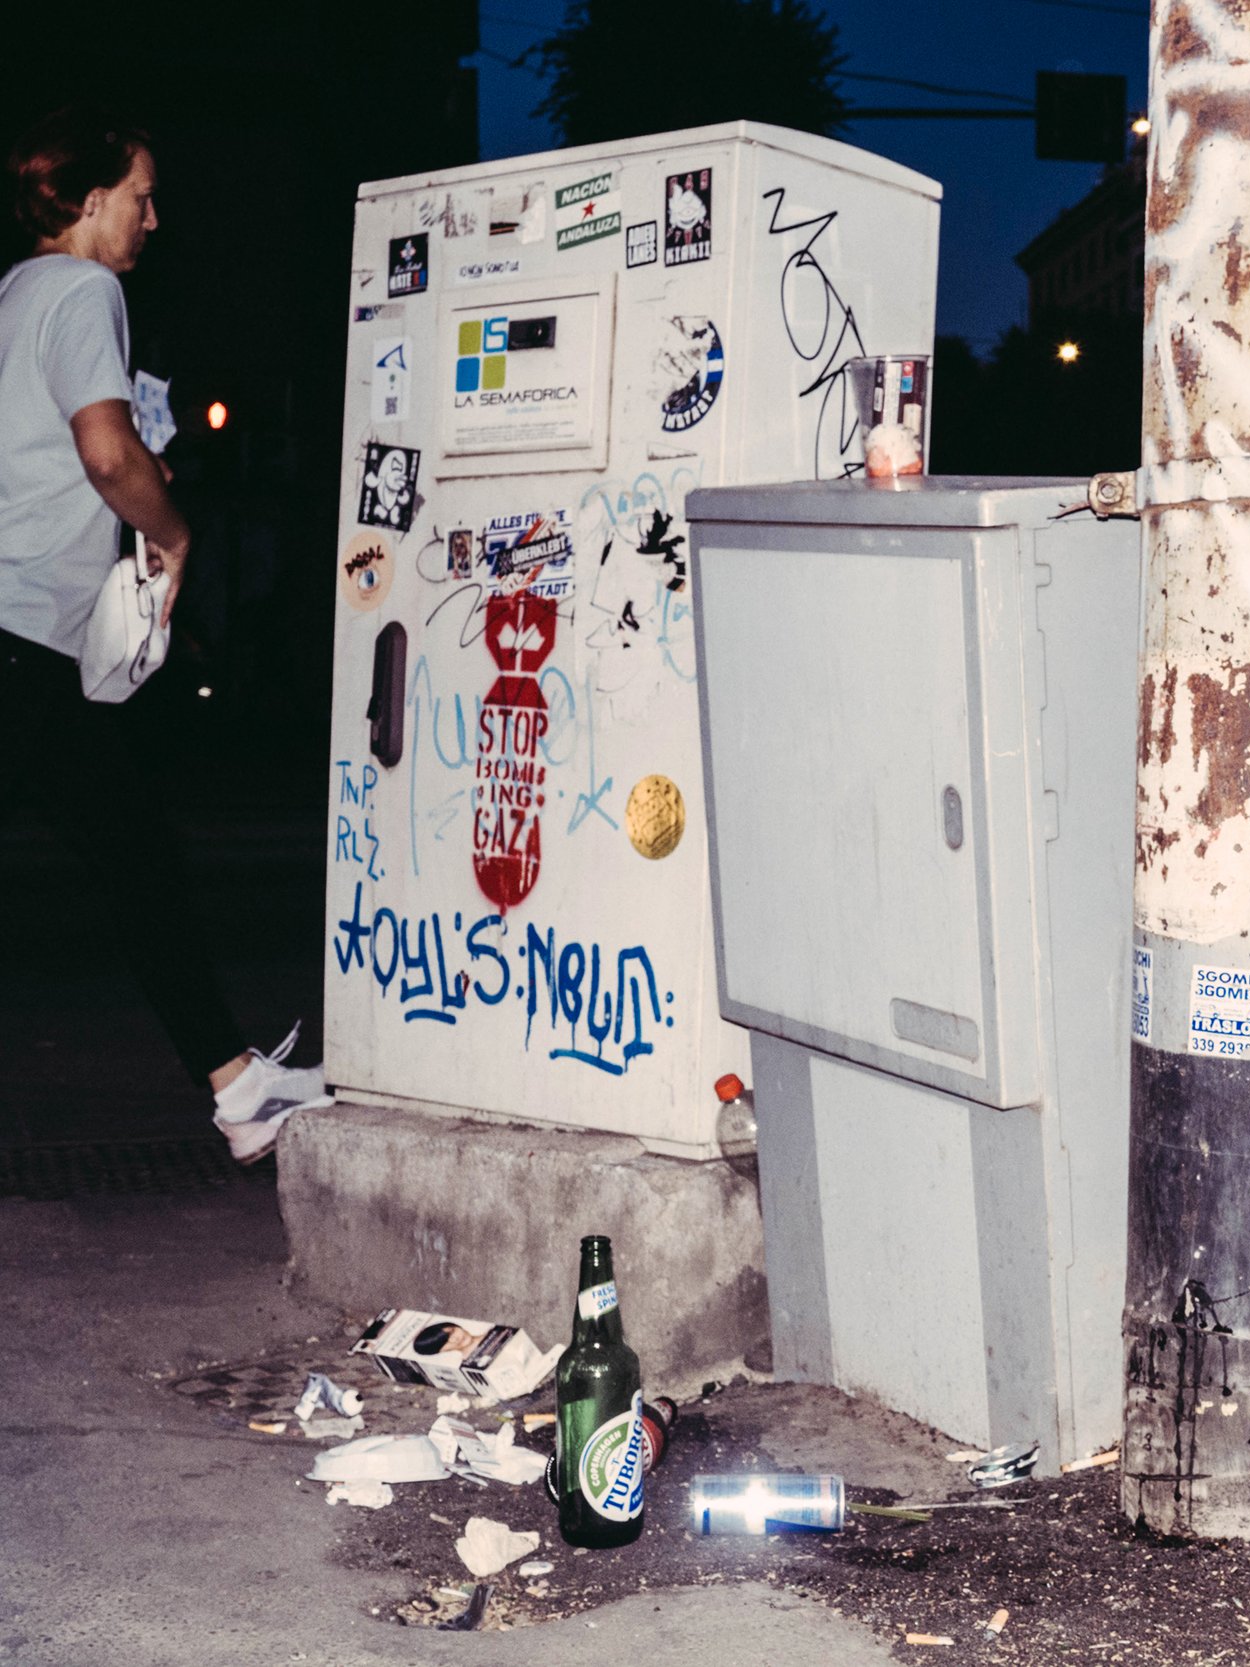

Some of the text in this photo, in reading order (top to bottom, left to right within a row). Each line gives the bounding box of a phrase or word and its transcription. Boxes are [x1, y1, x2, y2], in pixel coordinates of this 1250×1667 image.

[558, 214, 620, 246] ANDALUZA
[454, 387, 578, 408] LA SEMAFORICA
[489, 515, 522, 531] ALLES
[479, 708, 548, 758] STOP
[473, 807, 542, 858] GAZA
[1192, 1037, 1214, 1053] 339
[590, 1430, 622, 1487] COPENHAGEN
[602, 1419, 643, 1511] TUBORG
